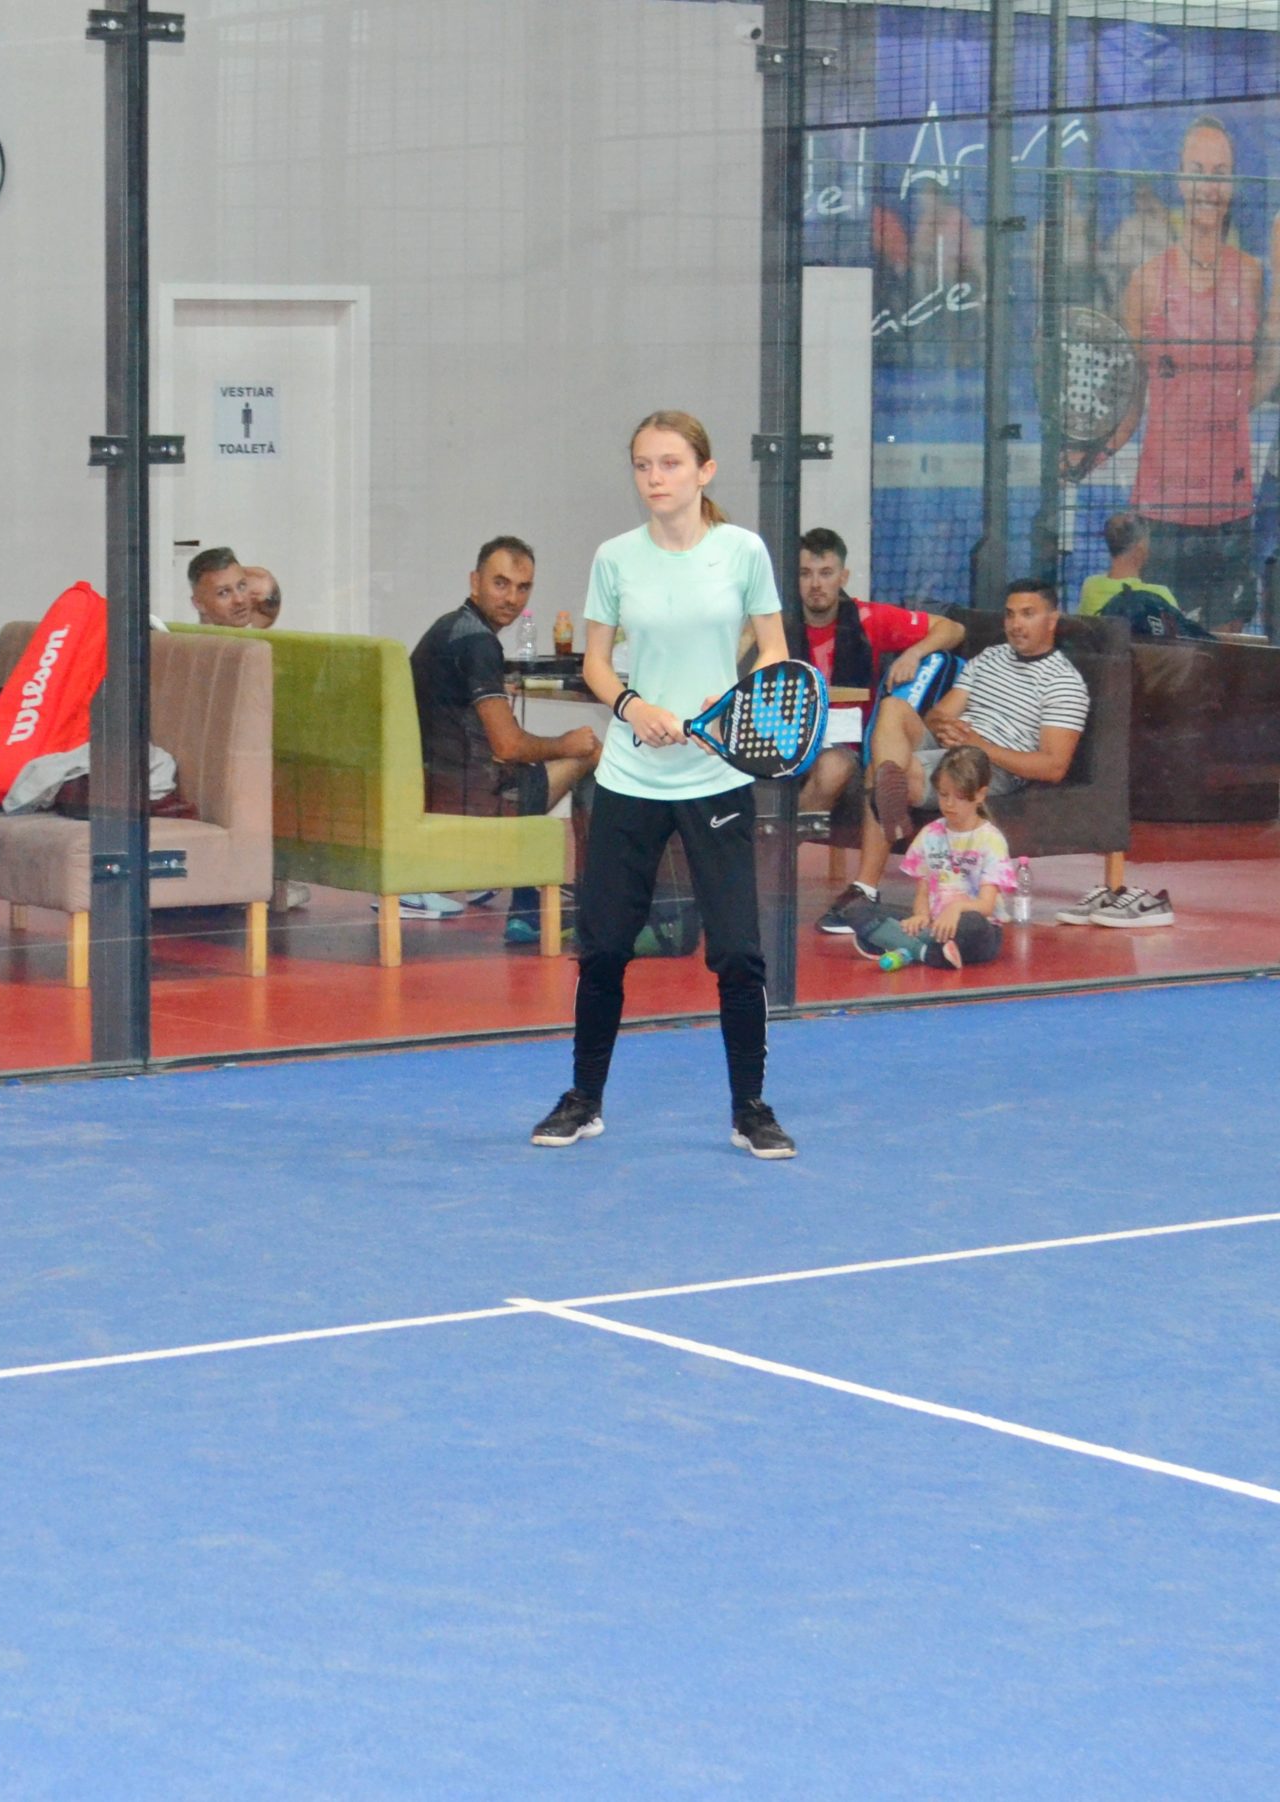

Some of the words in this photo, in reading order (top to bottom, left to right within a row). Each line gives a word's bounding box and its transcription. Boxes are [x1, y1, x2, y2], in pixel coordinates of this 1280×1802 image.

[900, 101, 1089, 200] Arna
[220, 386, 274, 397] VESTIAR
[5, 625, 69, 746] Wilson
[729, 690, 744, 755] Bullpadel
